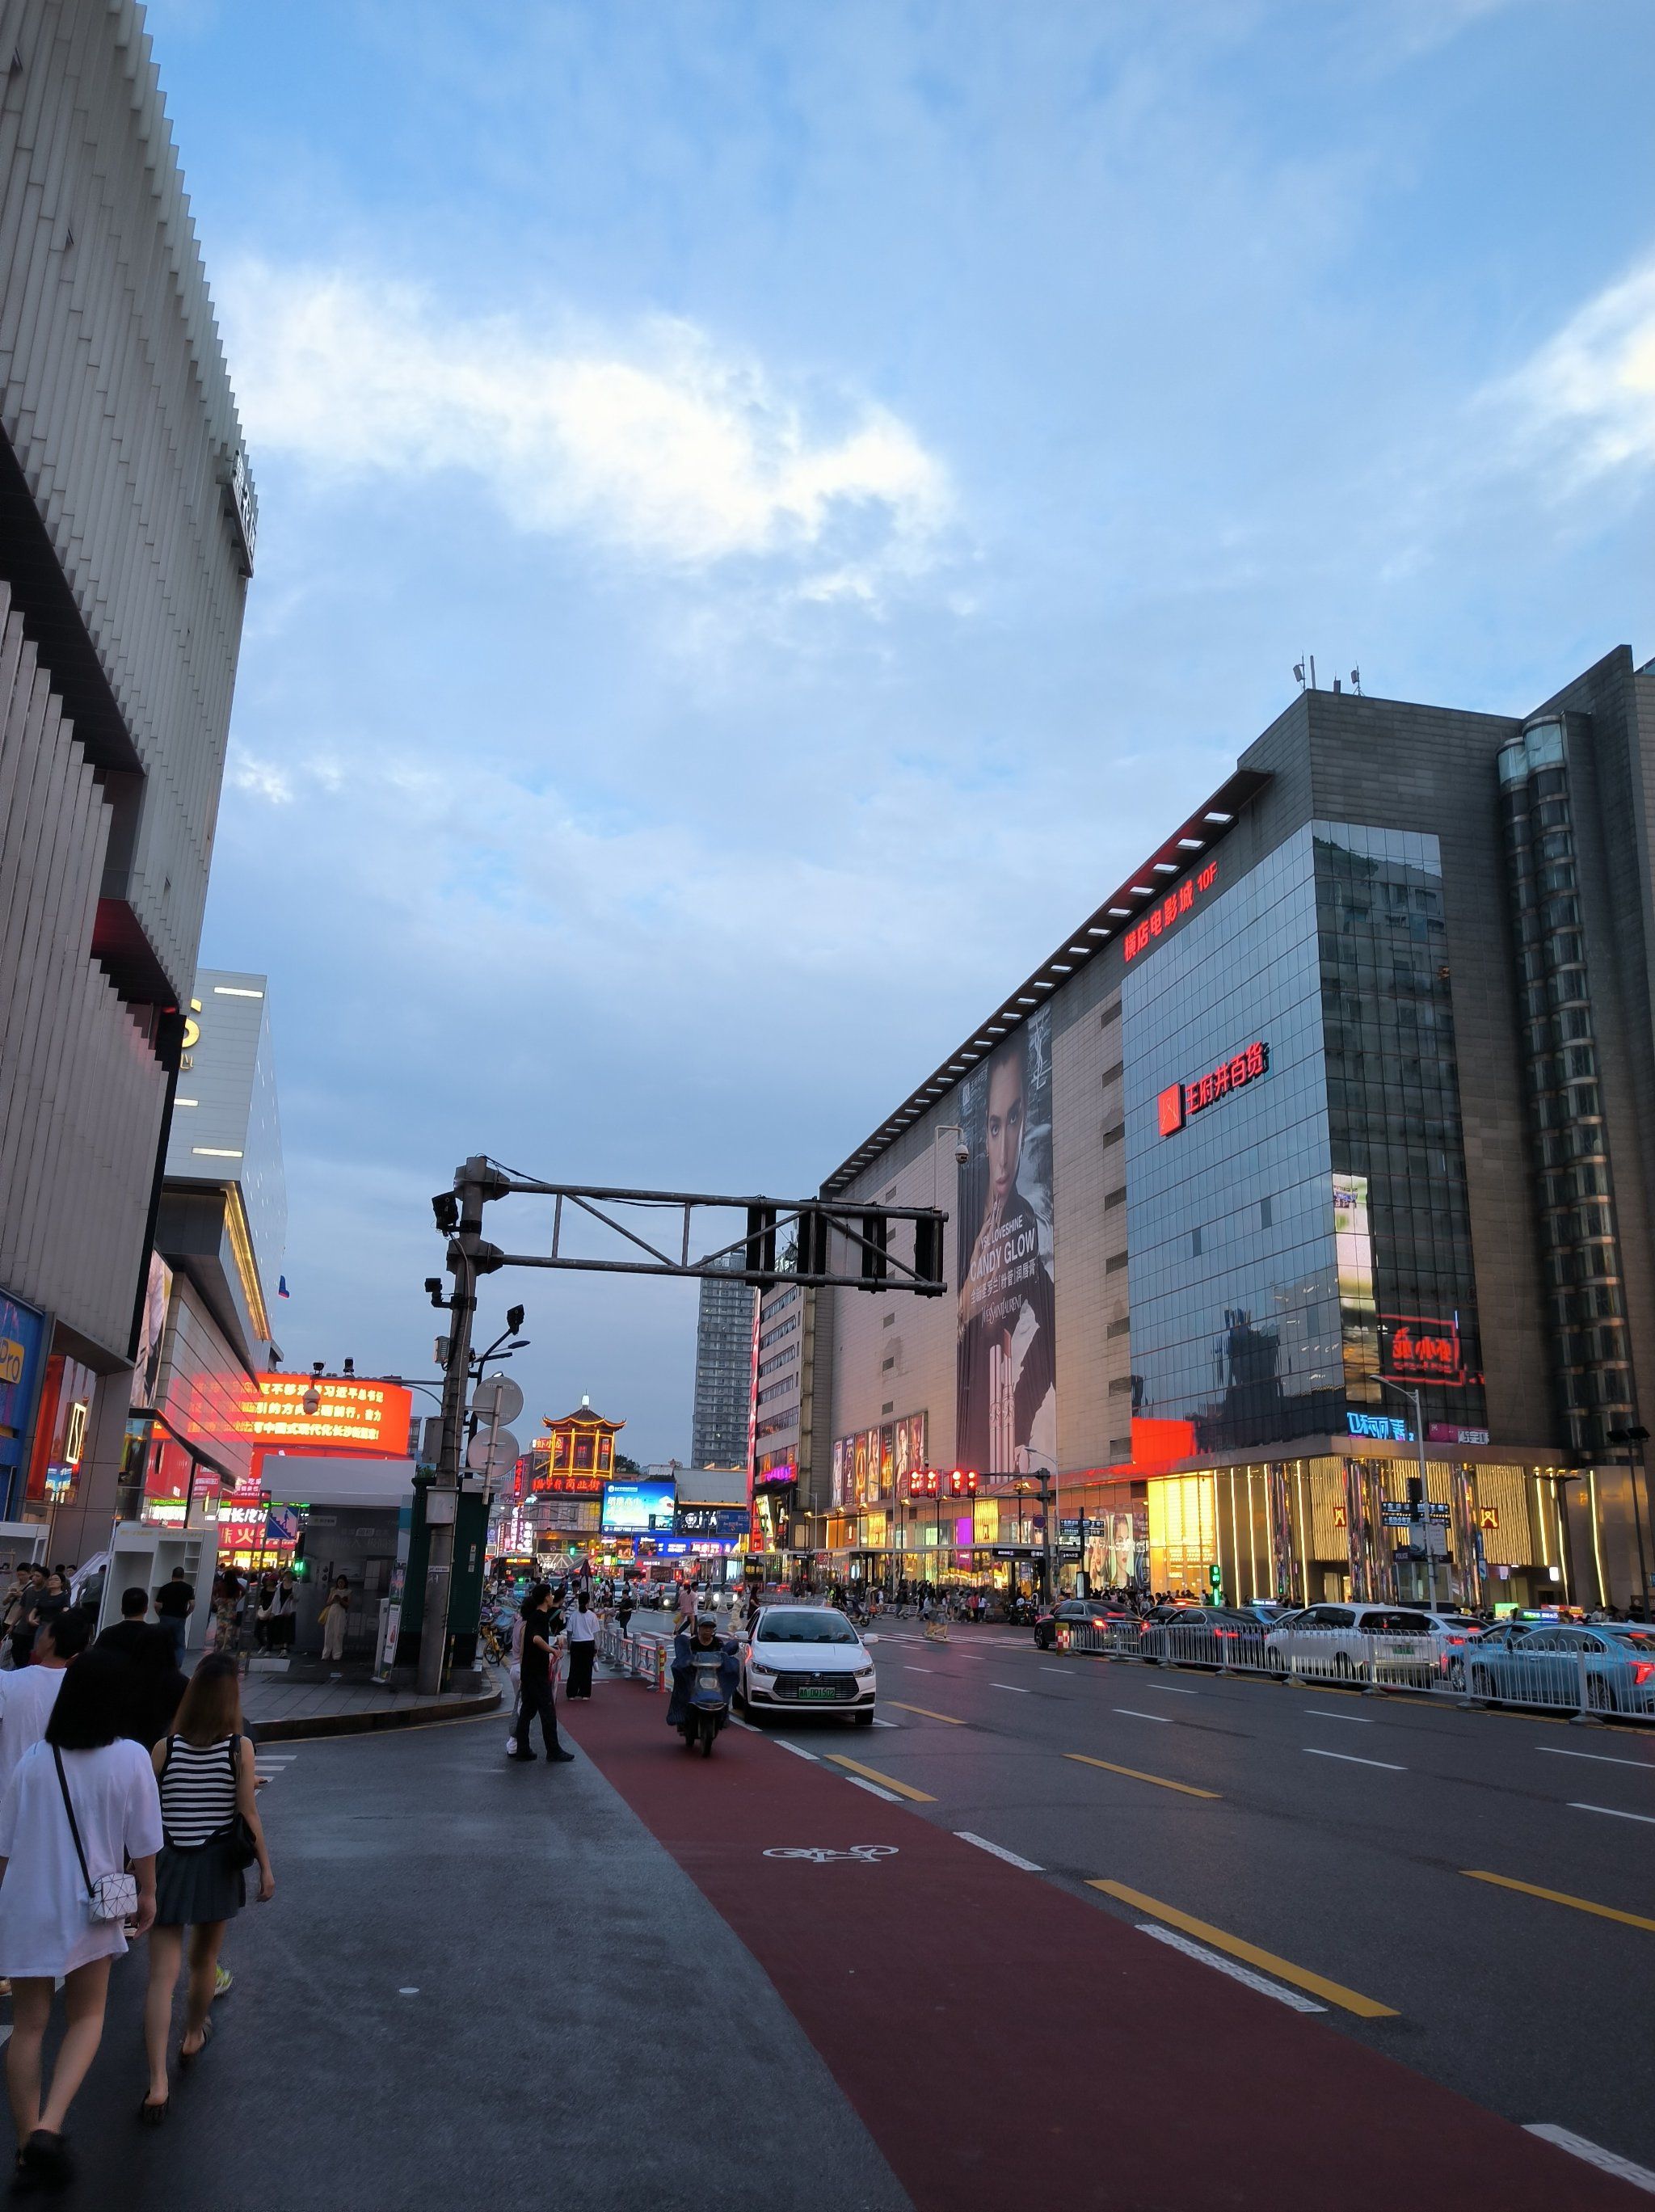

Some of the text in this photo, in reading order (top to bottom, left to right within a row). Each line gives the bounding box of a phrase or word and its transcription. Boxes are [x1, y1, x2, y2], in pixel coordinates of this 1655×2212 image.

[1123, 861, 1217, 963] 横店电影城 10F
[1185, 1041, 1263, 1115] 王府井百货
[970, 1228, 1035, 1282] CANDY GLOW
[980, 1214, 1023, 1249] YSL LOVESHINE
